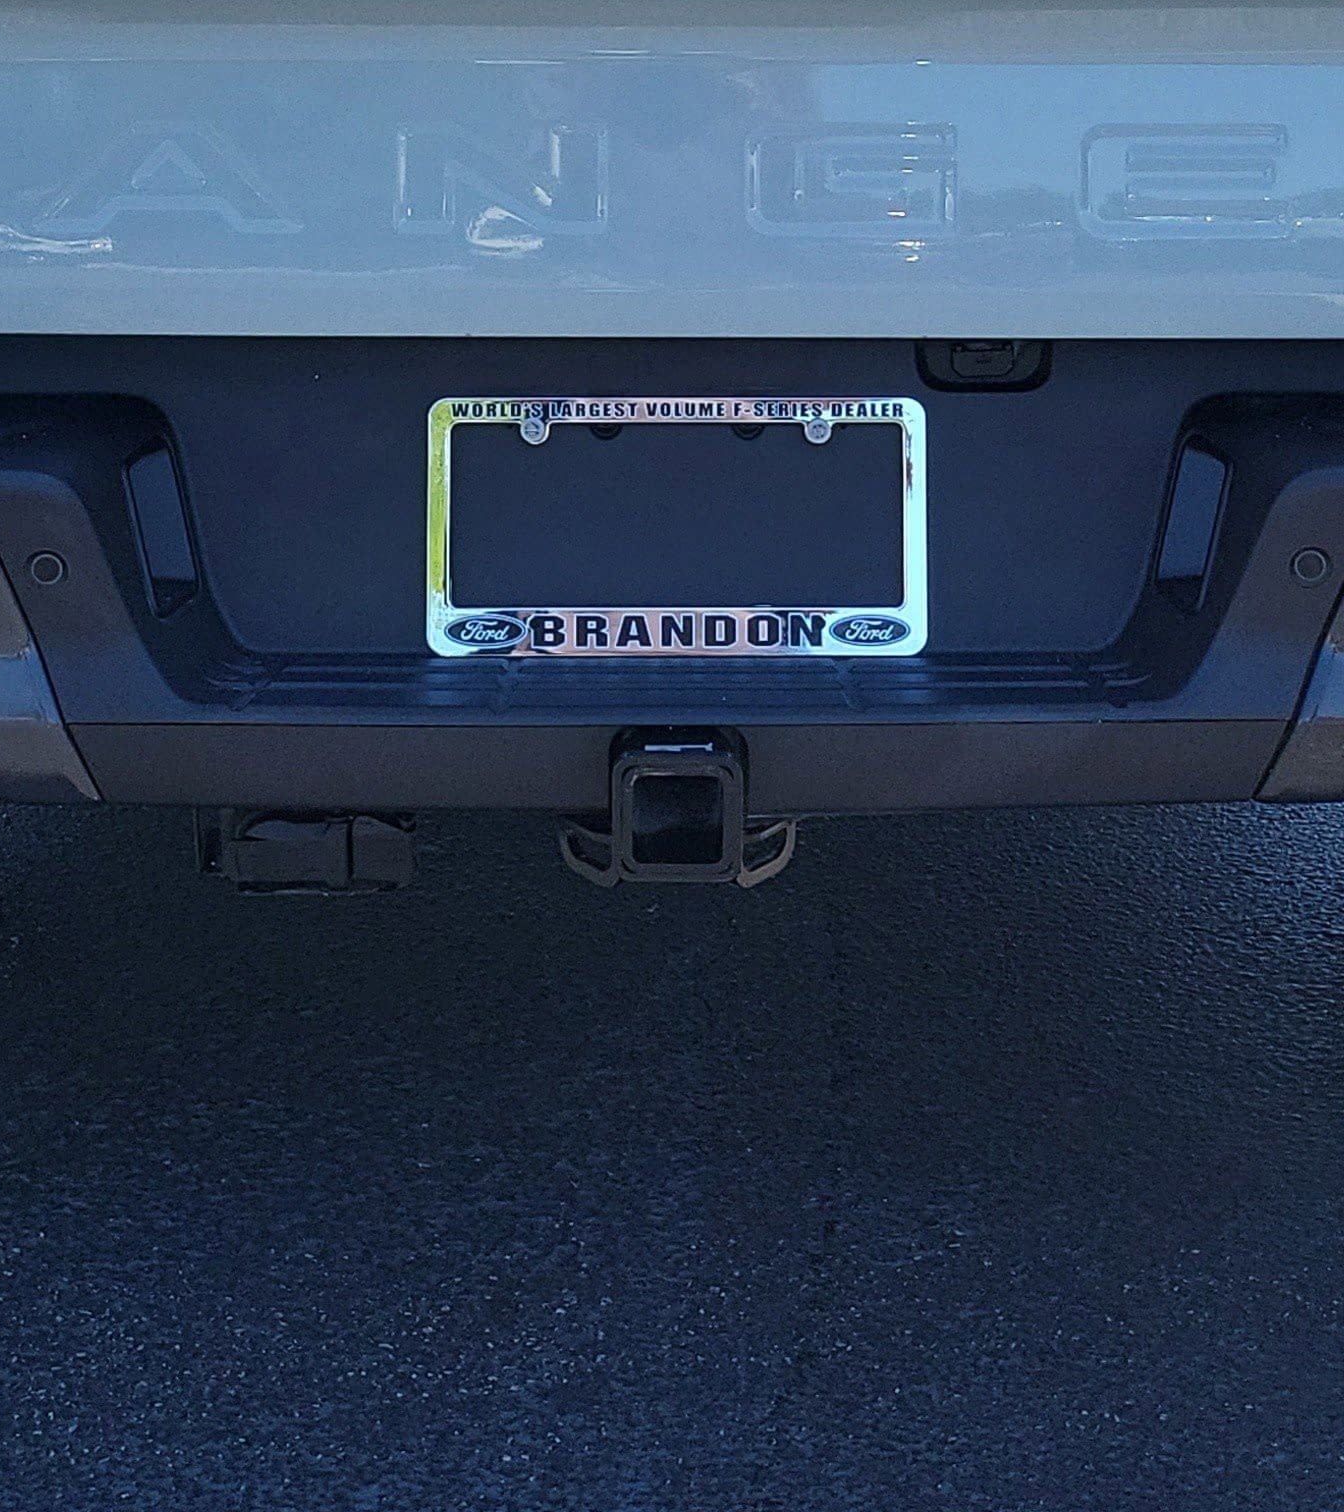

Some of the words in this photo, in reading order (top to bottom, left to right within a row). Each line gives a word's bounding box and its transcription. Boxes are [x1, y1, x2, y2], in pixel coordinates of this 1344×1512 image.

[452, 401, 544, 418] WORLD'S
[551, 402, 638, 418] LARGEST
[646, 402, 725, 418] VOLUME
[734, 402, 823, 418] F-SERIES
[831, 402, 904, 418] DEALER
[460, 619, 510, 641] Ford
[528, 614, 826, 648] BRANDON
[844, 619, 895, 641] Ford
